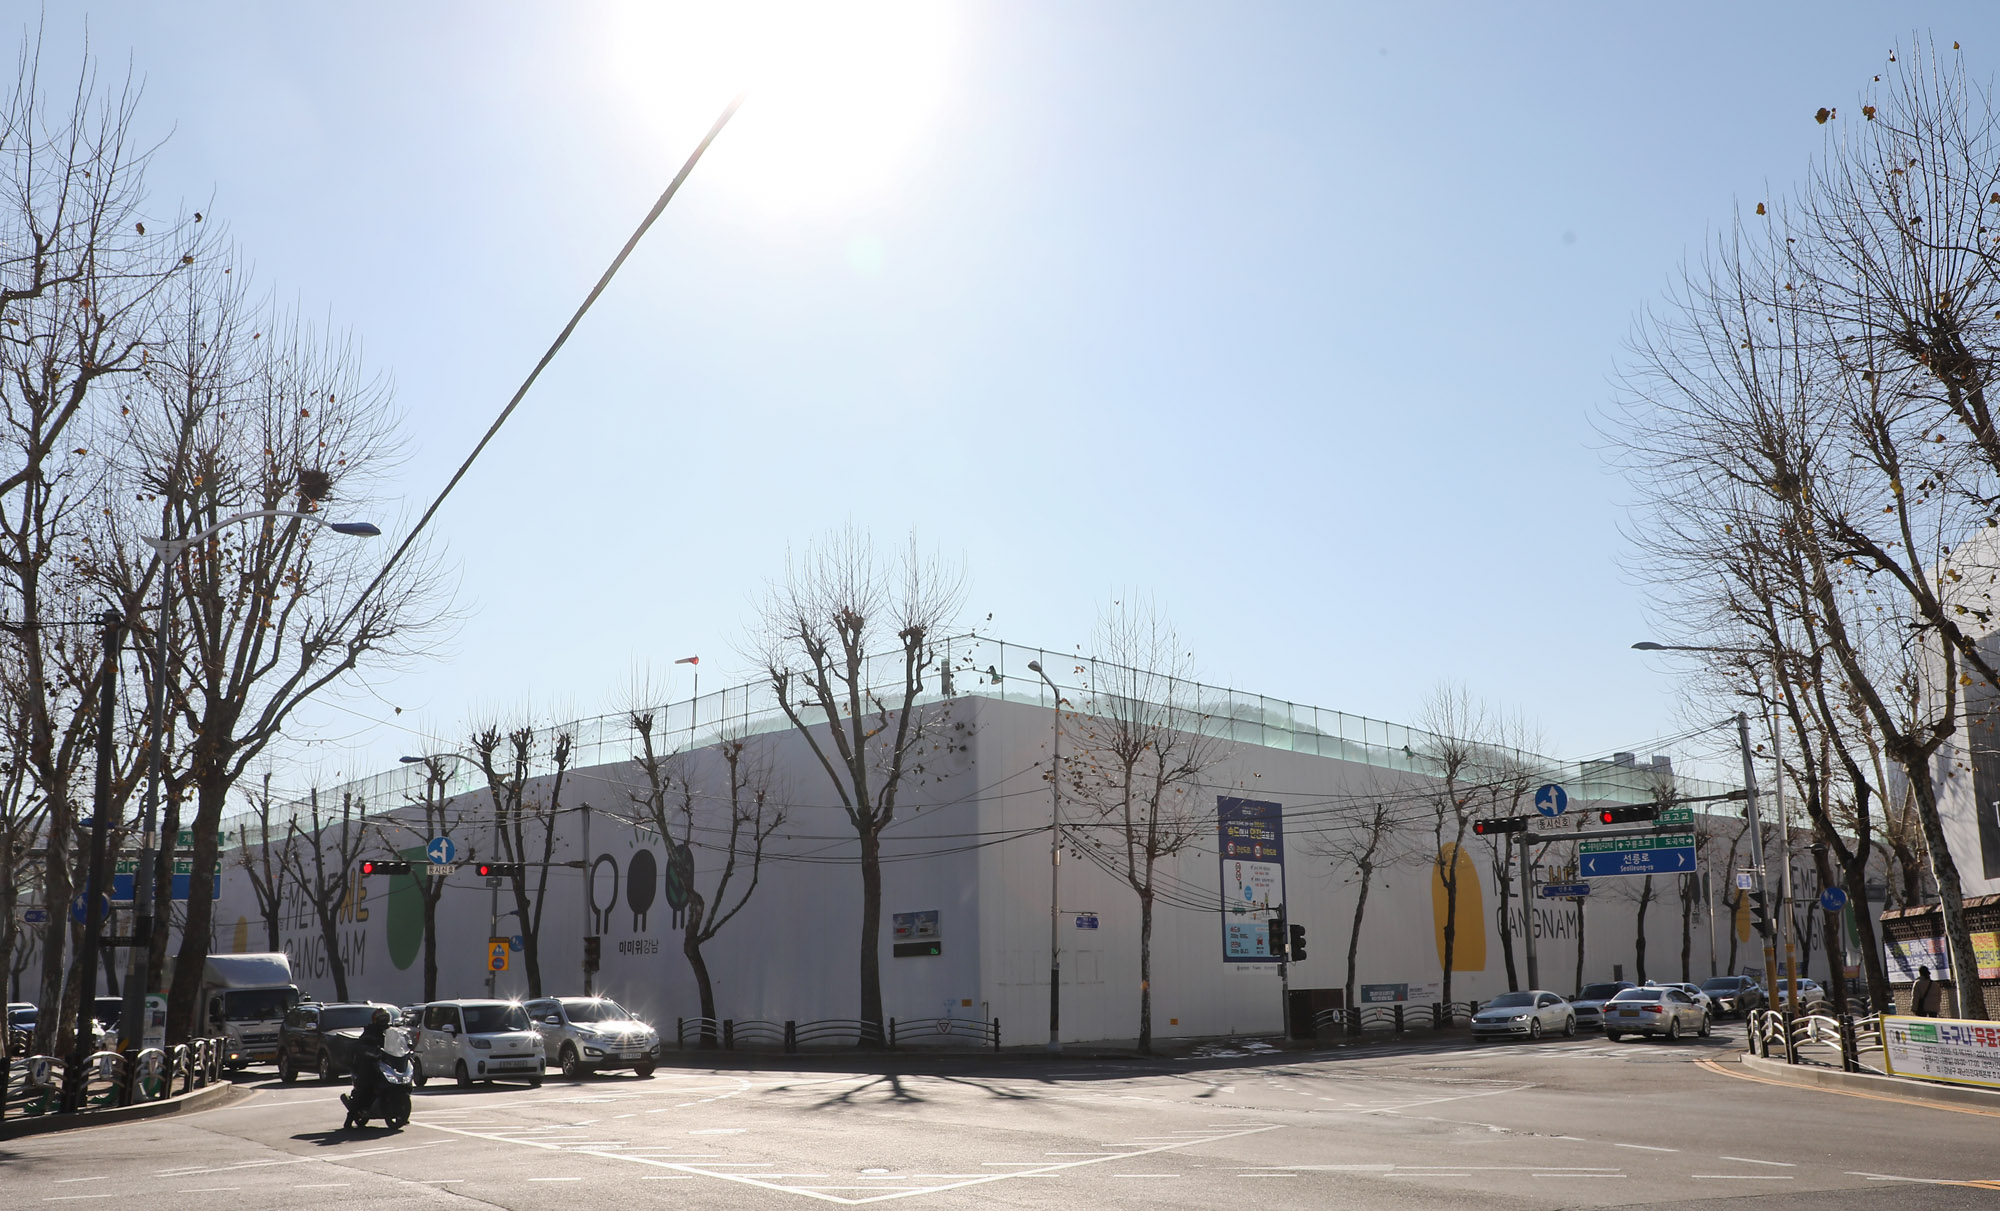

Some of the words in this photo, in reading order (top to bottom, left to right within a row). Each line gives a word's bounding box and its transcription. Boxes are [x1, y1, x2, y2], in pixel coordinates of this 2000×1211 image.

[1539, 817, 1569, 829] 동시신호
[1623, 853, 1651, 865] 선릉로
[1620, 864, 1654, 872] Seolleung-ro
[1492, 861, 1546, 900] MEE
[618, 938, 659, 956] 미미위강남
[1941, 1026, 1972, 1046] 누구나
